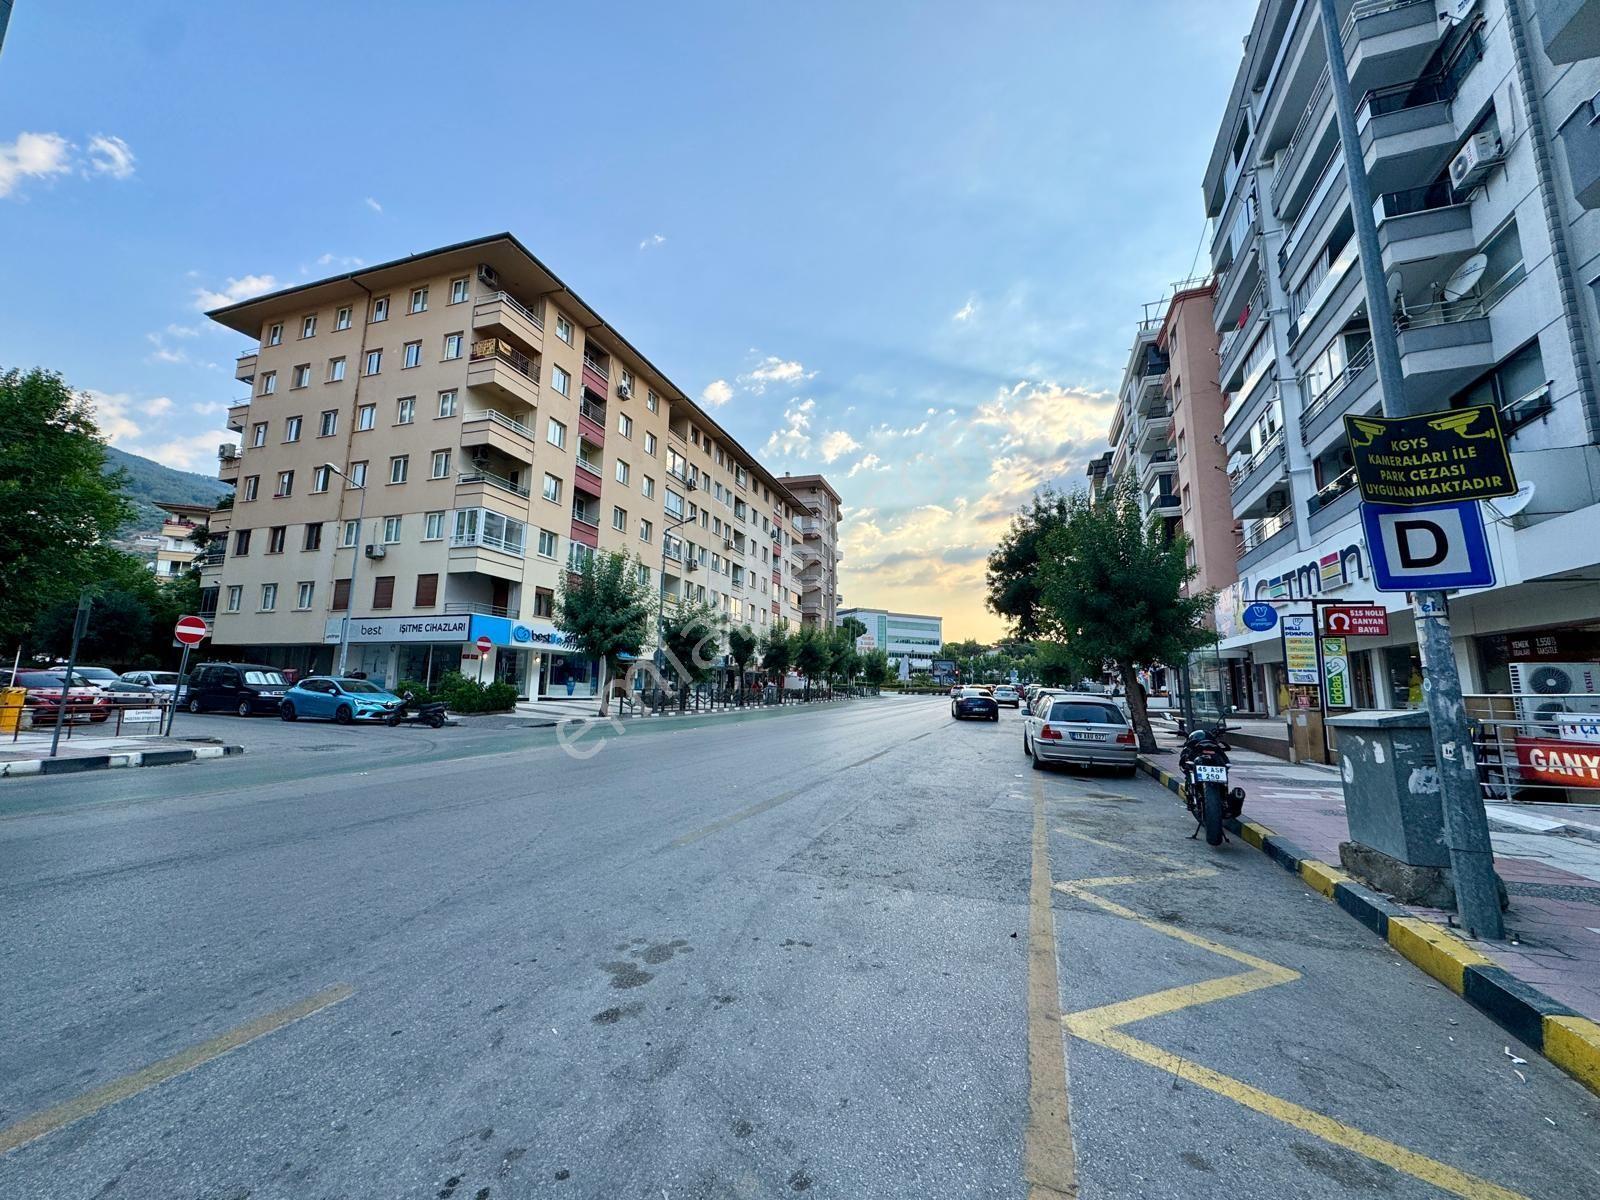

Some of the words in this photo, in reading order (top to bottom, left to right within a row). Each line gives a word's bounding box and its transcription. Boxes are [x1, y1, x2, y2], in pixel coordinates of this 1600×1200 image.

[1391, 437, 1428, 452] KGYS
[1368, 451, 1448, 467] KAMERALARI
[1453, 446, 1477, 460] İLE
[1380, 468, 1407, 482] PARK
[1410, 464, 1466, 481] CEZASI
[1366, 475, 1503, 497] UYGULANMAKTADIR
[1394, 520, 1449, 569] D
[361, 625, 382, 636] best
[1331, 675, 1344, 704] iddaa
